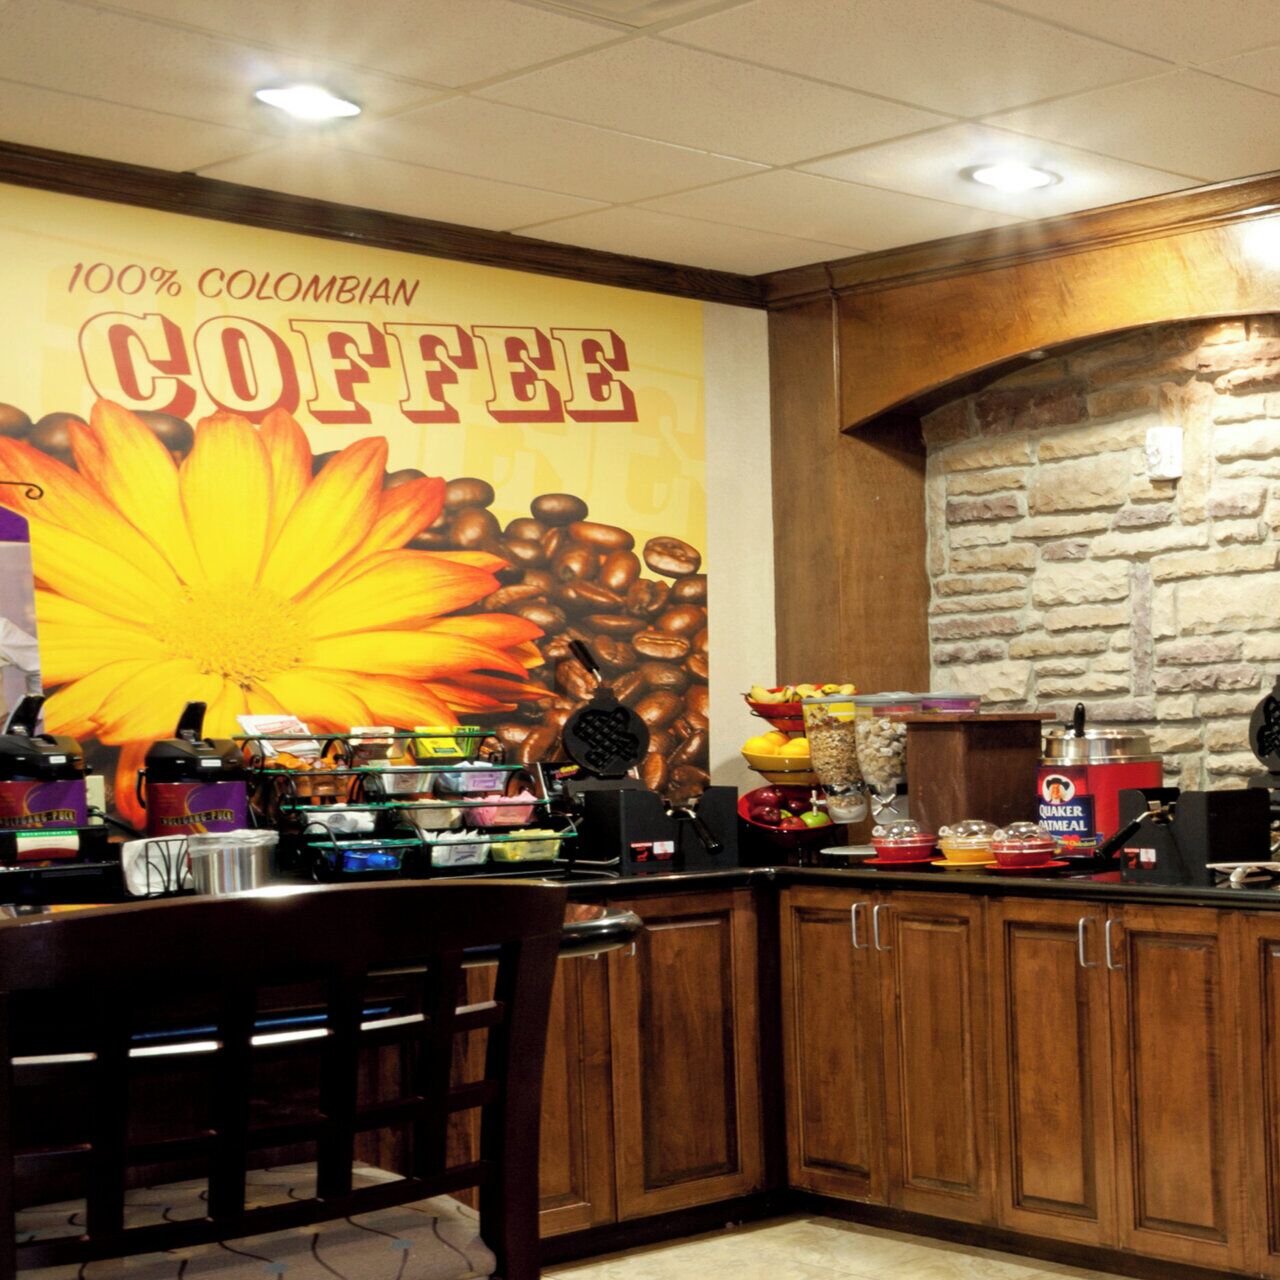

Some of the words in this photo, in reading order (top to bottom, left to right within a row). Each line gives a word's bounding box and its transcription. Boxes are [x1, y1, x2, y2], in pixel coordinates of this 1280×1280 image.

[66, 261, 183, 299] 100%
[198, 267, 421, 309] COLOMBIAN
[77, 310, 641, 425] COFFEE
[1039, 805, 1083, 819] QUAKER
[1039, 819, 1088, 832] OATMEAL
